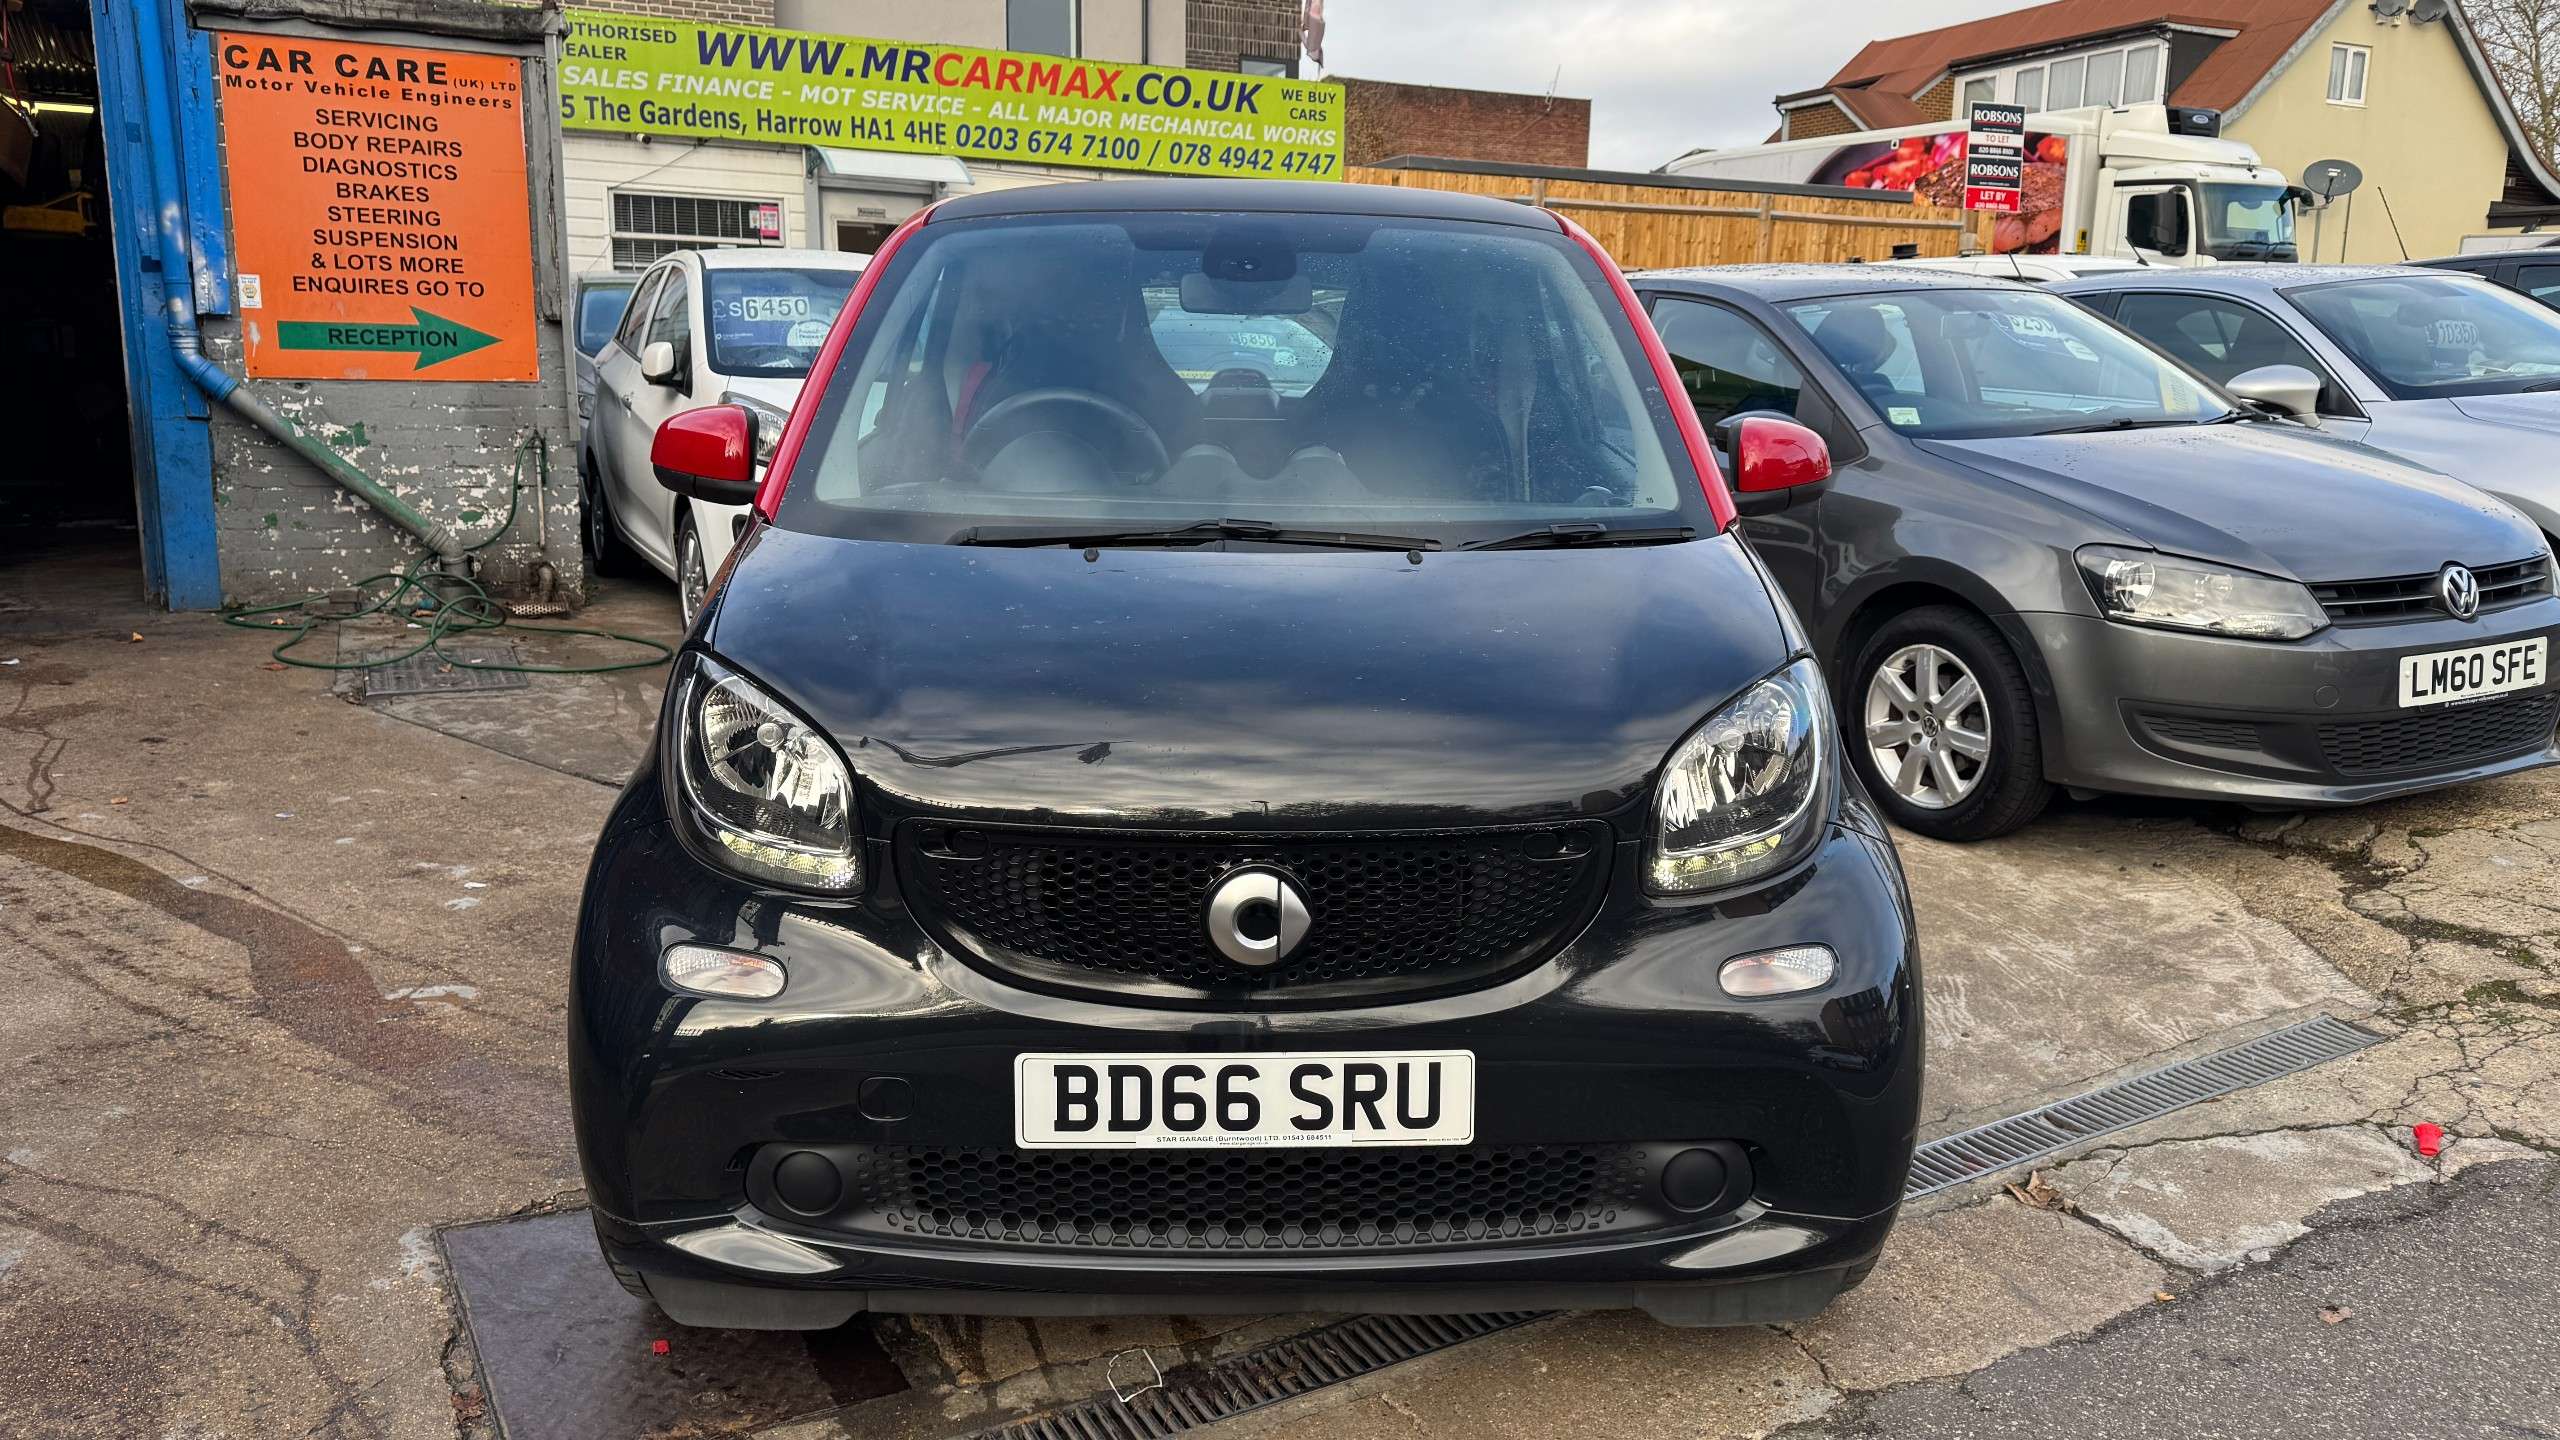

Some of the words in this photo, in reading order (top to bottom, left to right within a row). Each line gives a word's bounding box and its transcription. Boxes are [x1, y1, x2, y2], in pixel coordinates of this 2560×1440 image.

[565, 21, 677, 44] UTHORISED
[565, 42, 627, 61] EALER
[224, 44, 314, 75] CAR
[334, 53, 448, 85] CARE
[453, 78, 485, 91] (UK)
[490, 81, 517, 92] LTD
[697, 30, 1264, 114] WWW.MRCARMAX.CO.UK
[225, 74, 294, 92] Motor
[304, 80, 391, 99] Vehicle
[402, 88, 513, 109] Engineers
[1281, 88, 1304, 101] WE
[1308, 91, 1336, 104] BUY
[563, 65, 649, 91] SALES
[657, 72, 775, 100] FINANCE
[800, 84, 855, 106] MOT
[861, 90, 965, 116] SERVICE
[988, 101, 1030, 121] ALL
[1036, 106, 1112, 128] MAJOR
[1119, 112, 1255, 141] MECHANICAL
[1263, 125, 1337, 147] WORKS
[1289, 108, 1327, 121] CARS
[315, 108, 439, 132] SERVICING
[1974, 110, 2022, 124] ROBSONS
[294, 131, 359, 151] BODY
[366, 136, 463, 158] REPAIRS
[584, 95, 632, 122] The
[640, 99, 748, 136] Gardens,
[756, 109, 843, 138] Harrow
[851, 116, 896, 141] HA1
[904, 121, 947, 145] 4HE
[956, 124, 1019, 151] 0203
[1028, 130, 1073, 156] 674
[1082, 134, 1141, 161] 7100
[1169, 142, 1212, 167] 078
[1218, 146, 1274, 171] 4942
[1281, 151, 1336, 175] 4747
[1985, 134, 1996, 143] TO
[1997, 135, 2010, 143] LET
[303, 156, 458, 181] DIAGNOSTICS
[1970, 164, 2019, 177] ROBSONS
[336, 182, 430, 203] BRAKES
[1980, 190, 1995, 200] LET
[1996, 191, 2007, 201] BY
[328, 206, 441, 226] STEERING
[313, 229, 458, 250] SUSPENSION
[311, 253, 326, 269] &
[334, 253, 393, 271] LOTS
[400, 256, 465, 274] MORE
[293, 275, 409, 295] ENQUIRES
[416, 280, 450, 296] GO
[456, 281, 485, 297] TO
[328, 328, 458, 347] RECEPTION
[2411, 653, 2484, 698] LM60
[2492, 644, 2538, 686] SFE
[1054, 1064, 1261, 1132] BD66
[1290, 1062, 1441, 1132] SRU
